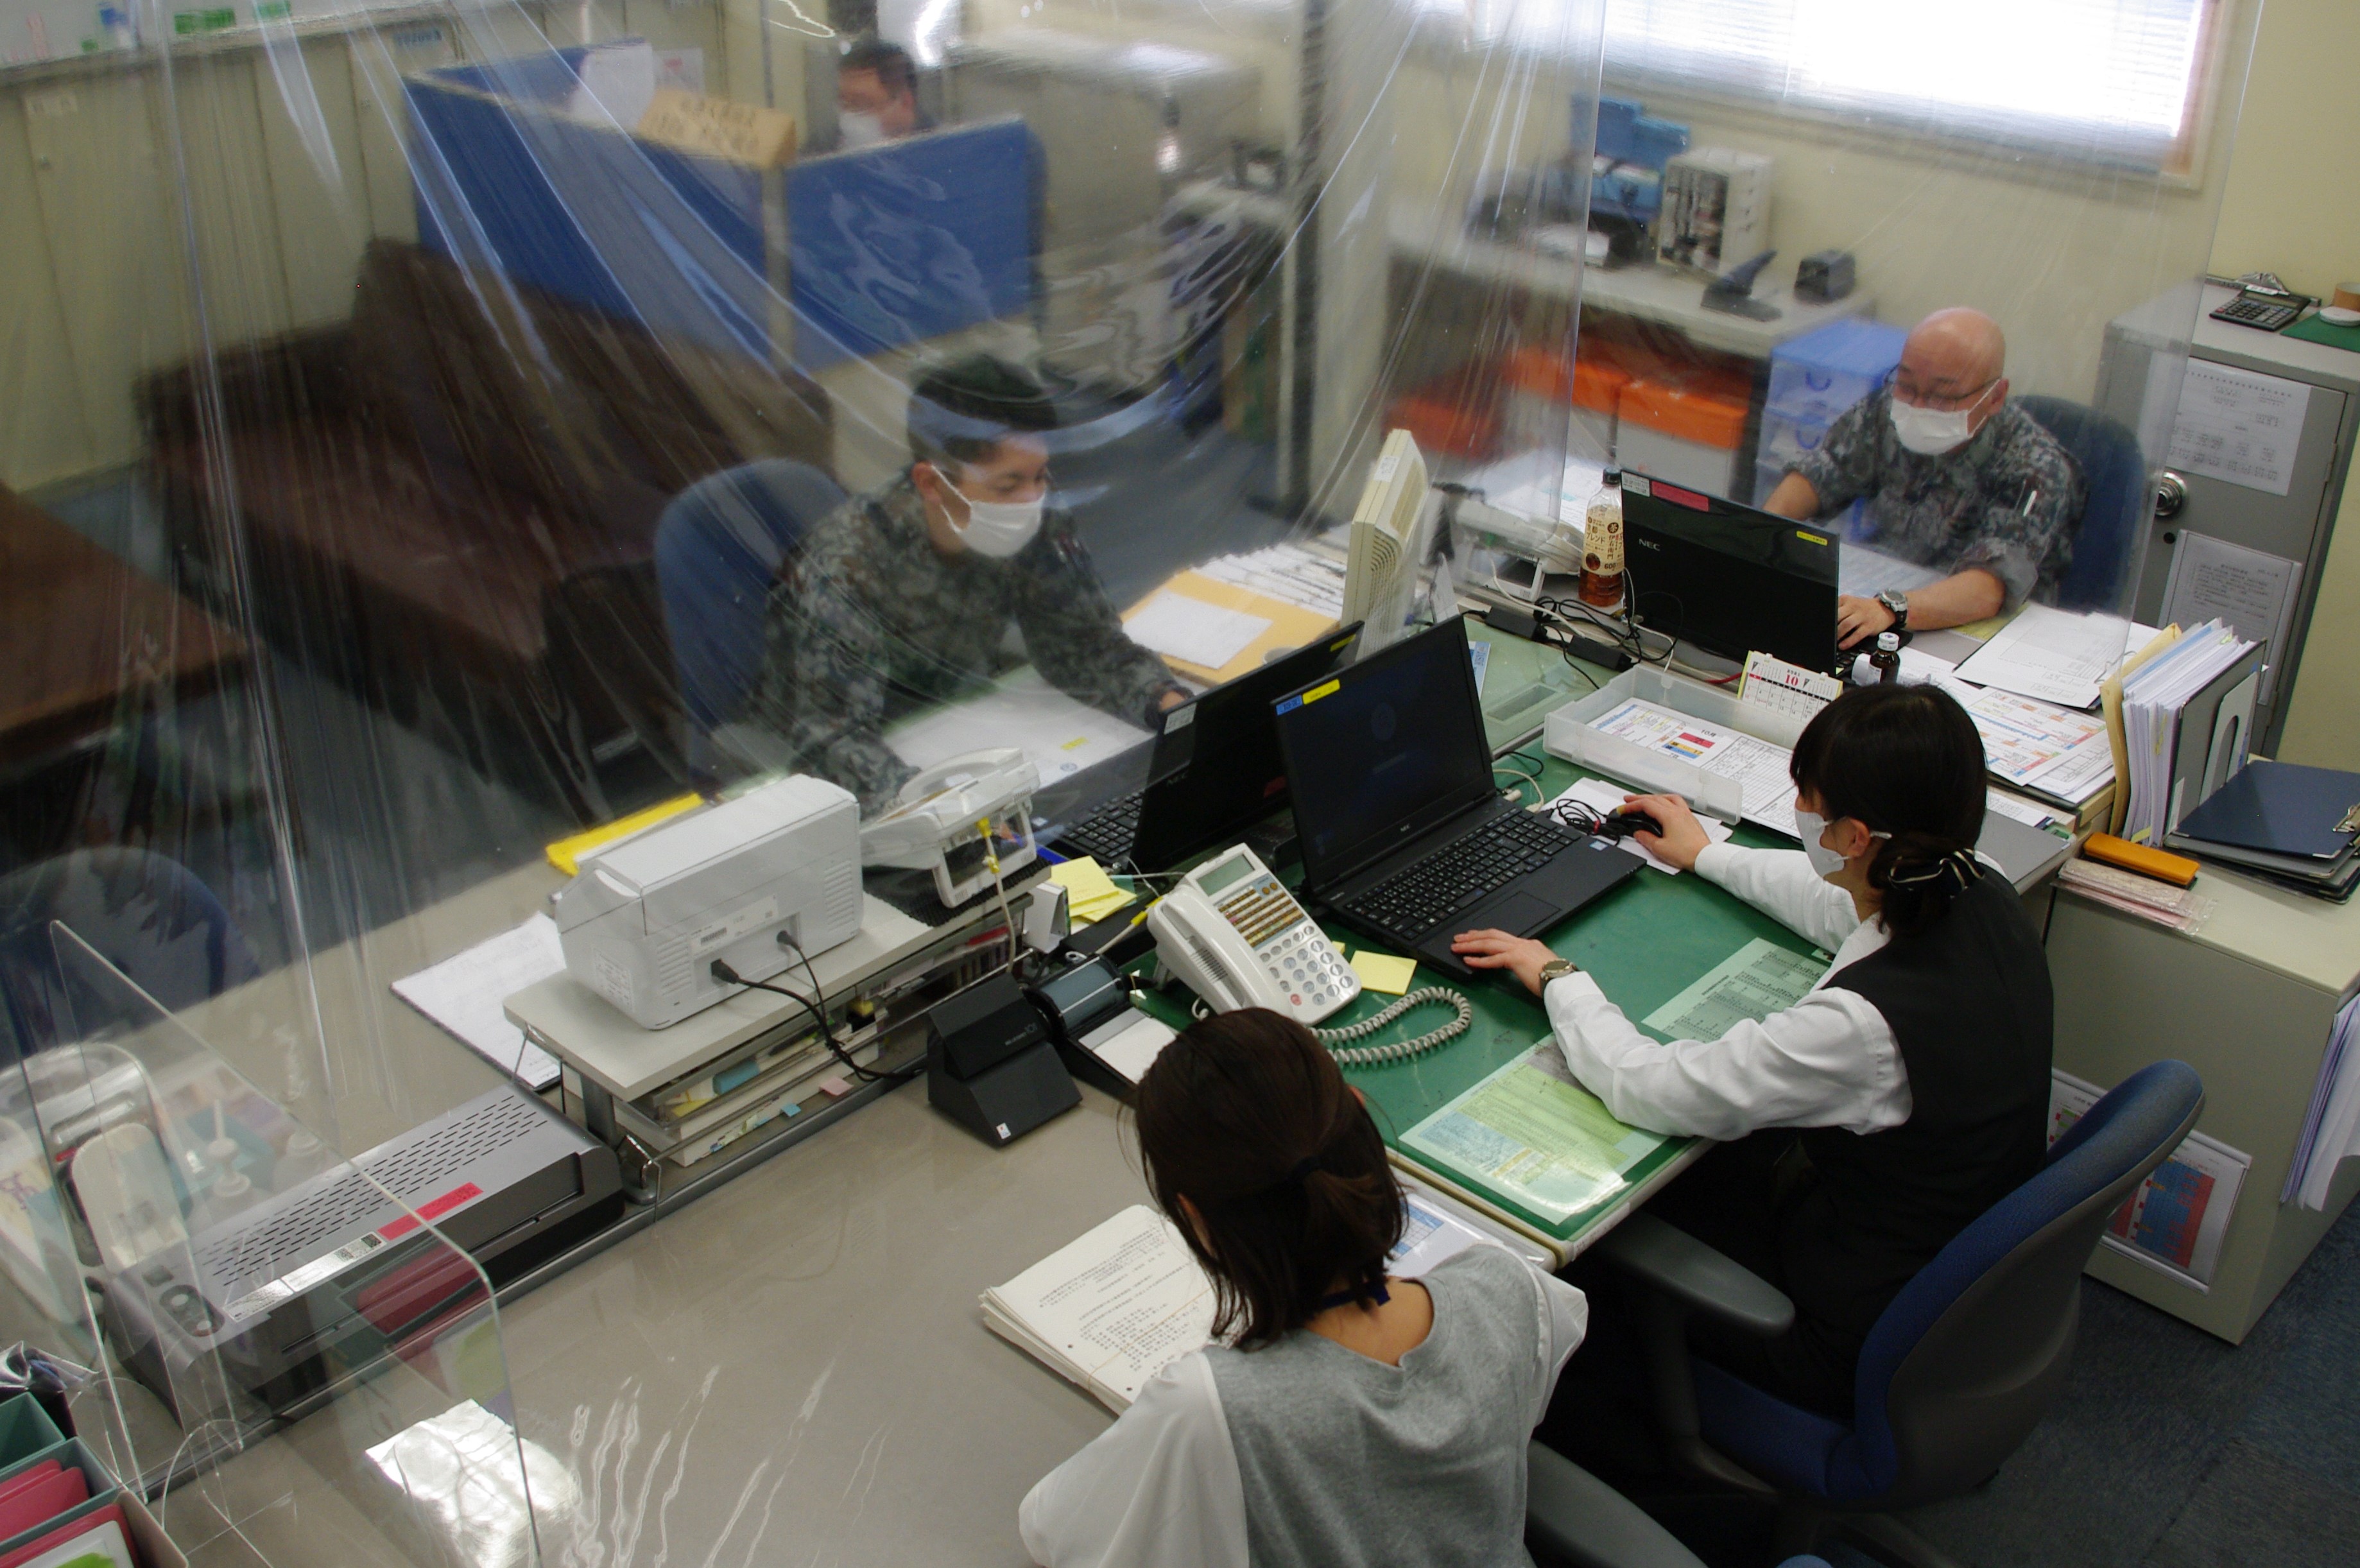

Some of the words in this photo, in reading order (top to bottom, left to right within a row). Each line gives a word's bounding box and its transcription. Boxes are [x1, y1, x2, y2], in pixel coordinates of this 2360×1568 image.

[1587, 532, 1606, 544] ブレンド
[1639, 538, 1660, 551] NEC
[1606, 535, 1615, 560] 伊右衛門
[1785, 674, 1798, 687] 10
